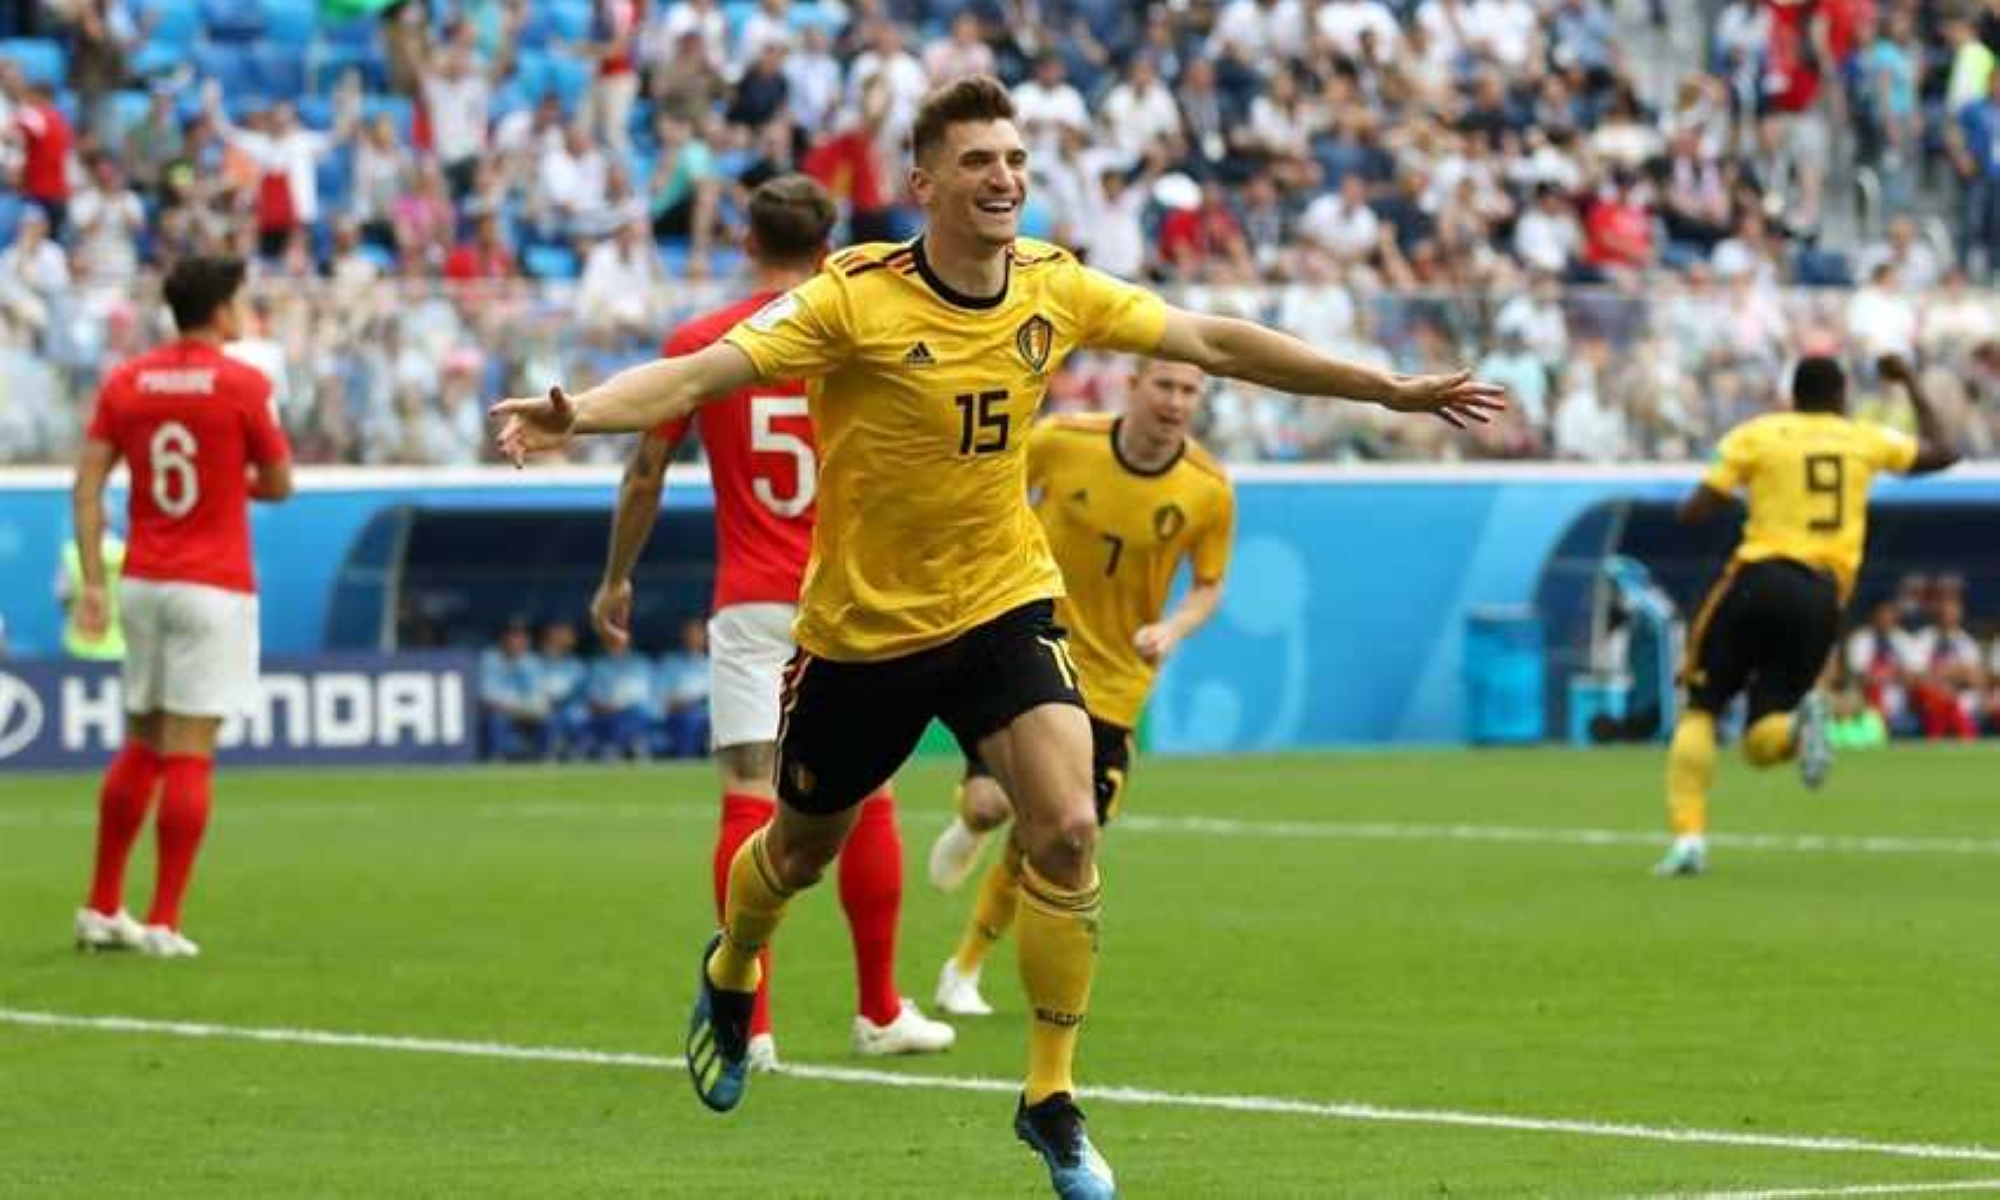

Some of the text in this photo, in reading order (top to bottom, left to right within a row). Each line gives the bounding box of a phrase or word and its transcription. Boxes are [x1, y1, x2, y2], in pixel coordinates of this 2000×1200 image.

[751, 396, 818, 518] 5
[955, 389, 1010, 455] 15
[151, 421, 199, 519] 6
[1805, 454, 1843, 531] 9
[1102, 532, 1124, 578] 7
[62, 672, 464, 750] HNDAI
